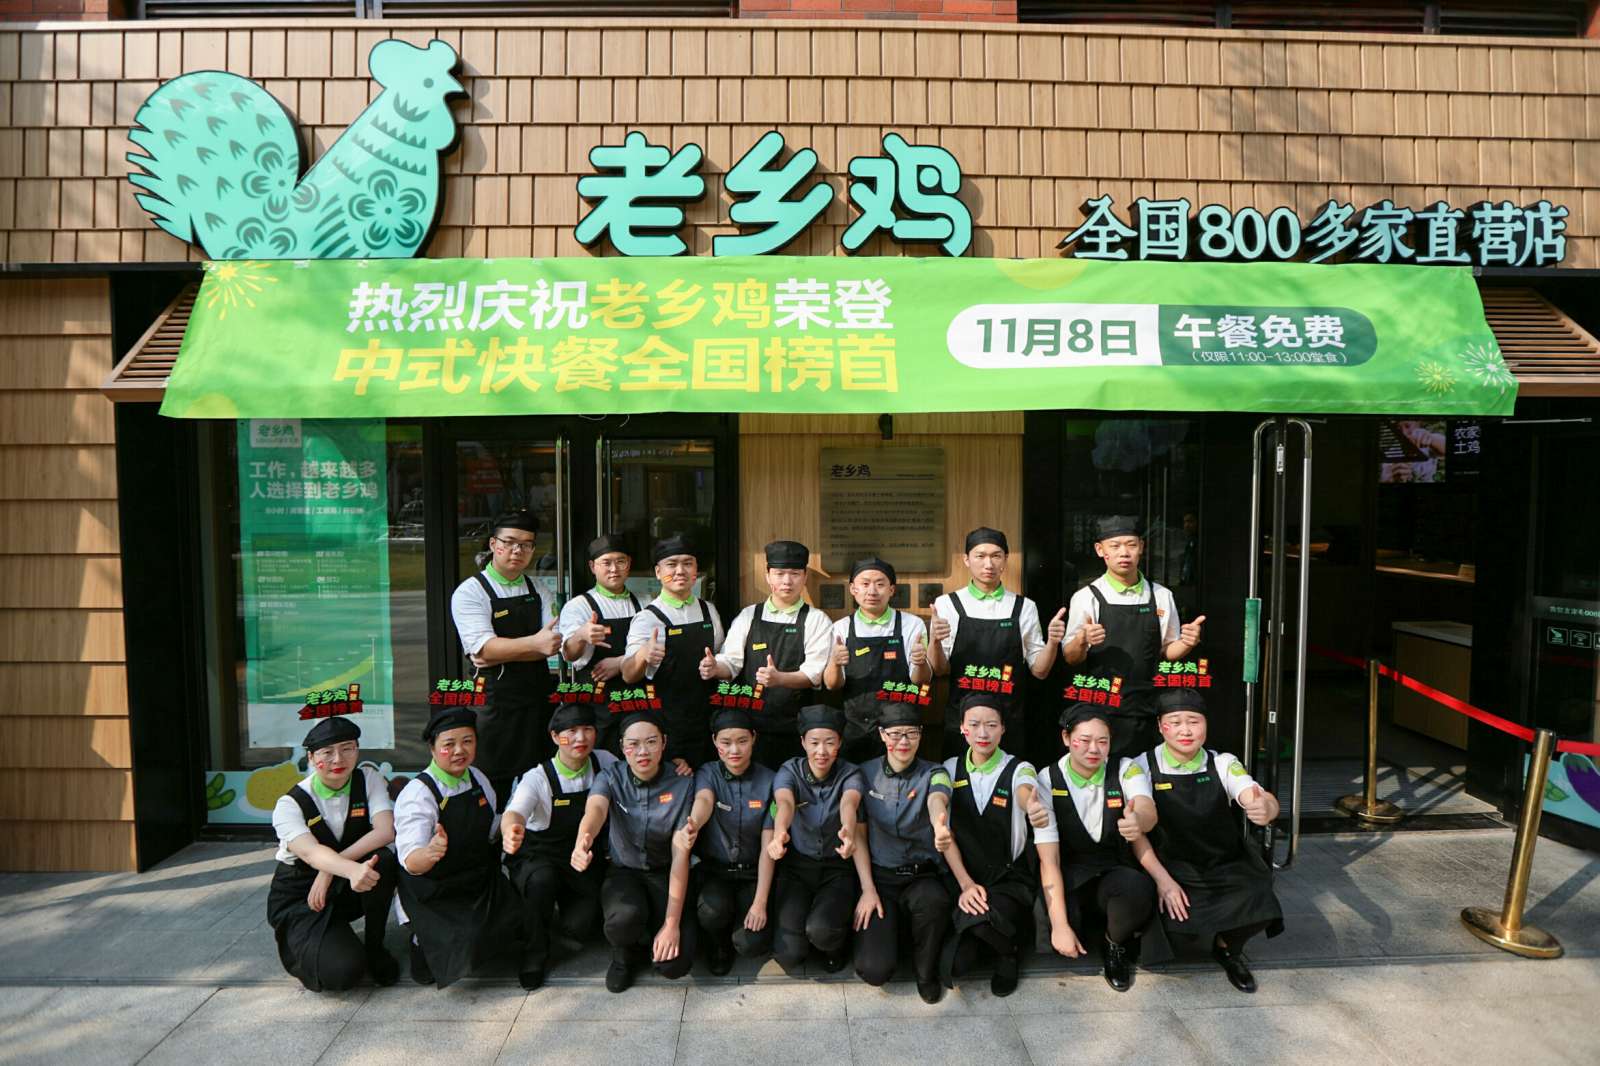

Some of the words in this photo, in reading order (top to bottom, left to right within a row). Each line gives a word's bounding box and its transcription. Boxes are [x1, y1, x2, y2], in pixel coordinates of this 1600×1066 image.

[573, 131, 972, 257] 老乡鸡
[1066, 194, 1569, 266] 全国800多家直营店
[347, 278, 895, 332] 热烈庆祝老乡鸡荣登
[976, 318, 1139, 357] 11月8日
[1173, 314, 1347, 350] 午餐免费
[333, 334, 899, 397] 中式快餐全国榜首
[258, 424, 295, 437] 老乡鸡
[1454, 426, 1481, 439] 农家
[831, 464, 871, 478] 老乡鸡
[250, 481, 378, 499] 人选择到老乡鸡
[964, 664, 1001, 680] 老乡鸡
[1158, 661, 1198, 674] 老乡鸡
[437, 679, 475, 692] 老乡鸡
[882, 680, 919, 695] 老乡鸡
[1072, 674, 1110, 692] 老乡鸡
[1152, 673, 1213, 688] 全国榜首
[305, 689, 348, 705] 老乡鸡
[609, 688, 647, 701] 老乡鸡
[717, 682, 753, 697] 老乡鸡
[1063, 686, 1122, 708] 全国榜首
